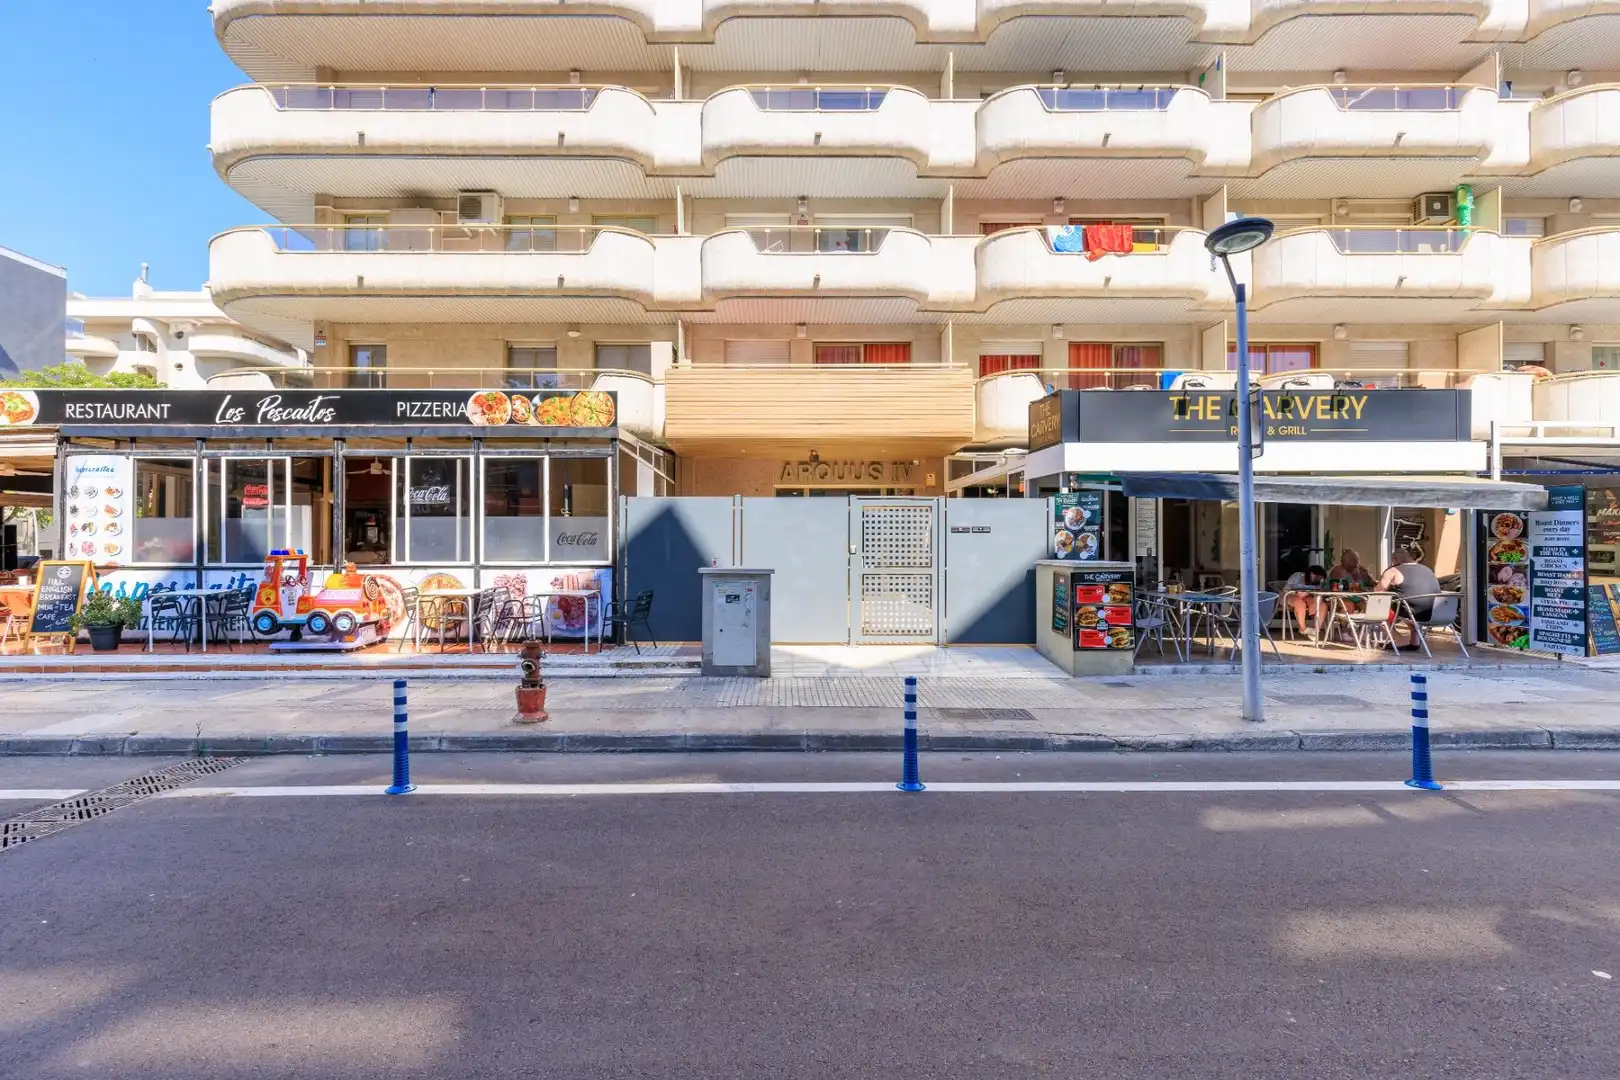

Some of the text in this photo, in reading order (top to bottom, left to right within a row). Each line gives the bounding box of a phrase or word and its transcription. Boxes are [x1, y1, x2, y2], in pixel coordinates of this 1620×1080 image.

[65, 403, 171, 419] RESTAURANT
[215, 394, 341, 423] Los Pescaitos
[396, 401, 468, 417] PIZZERIA
[1040, 400, 1051, 417] THE
[1169, 395, 1369, 420] THE ARVERY
[1030, 412, 1060, 438] CARVERY
[1267, 426, 1307, 436] & GRILL
[556, 531, 598, 546] Coca-Cola
[41, 585, 73, 594] ENGLISH
[60, 603, 74, 612] TEA
